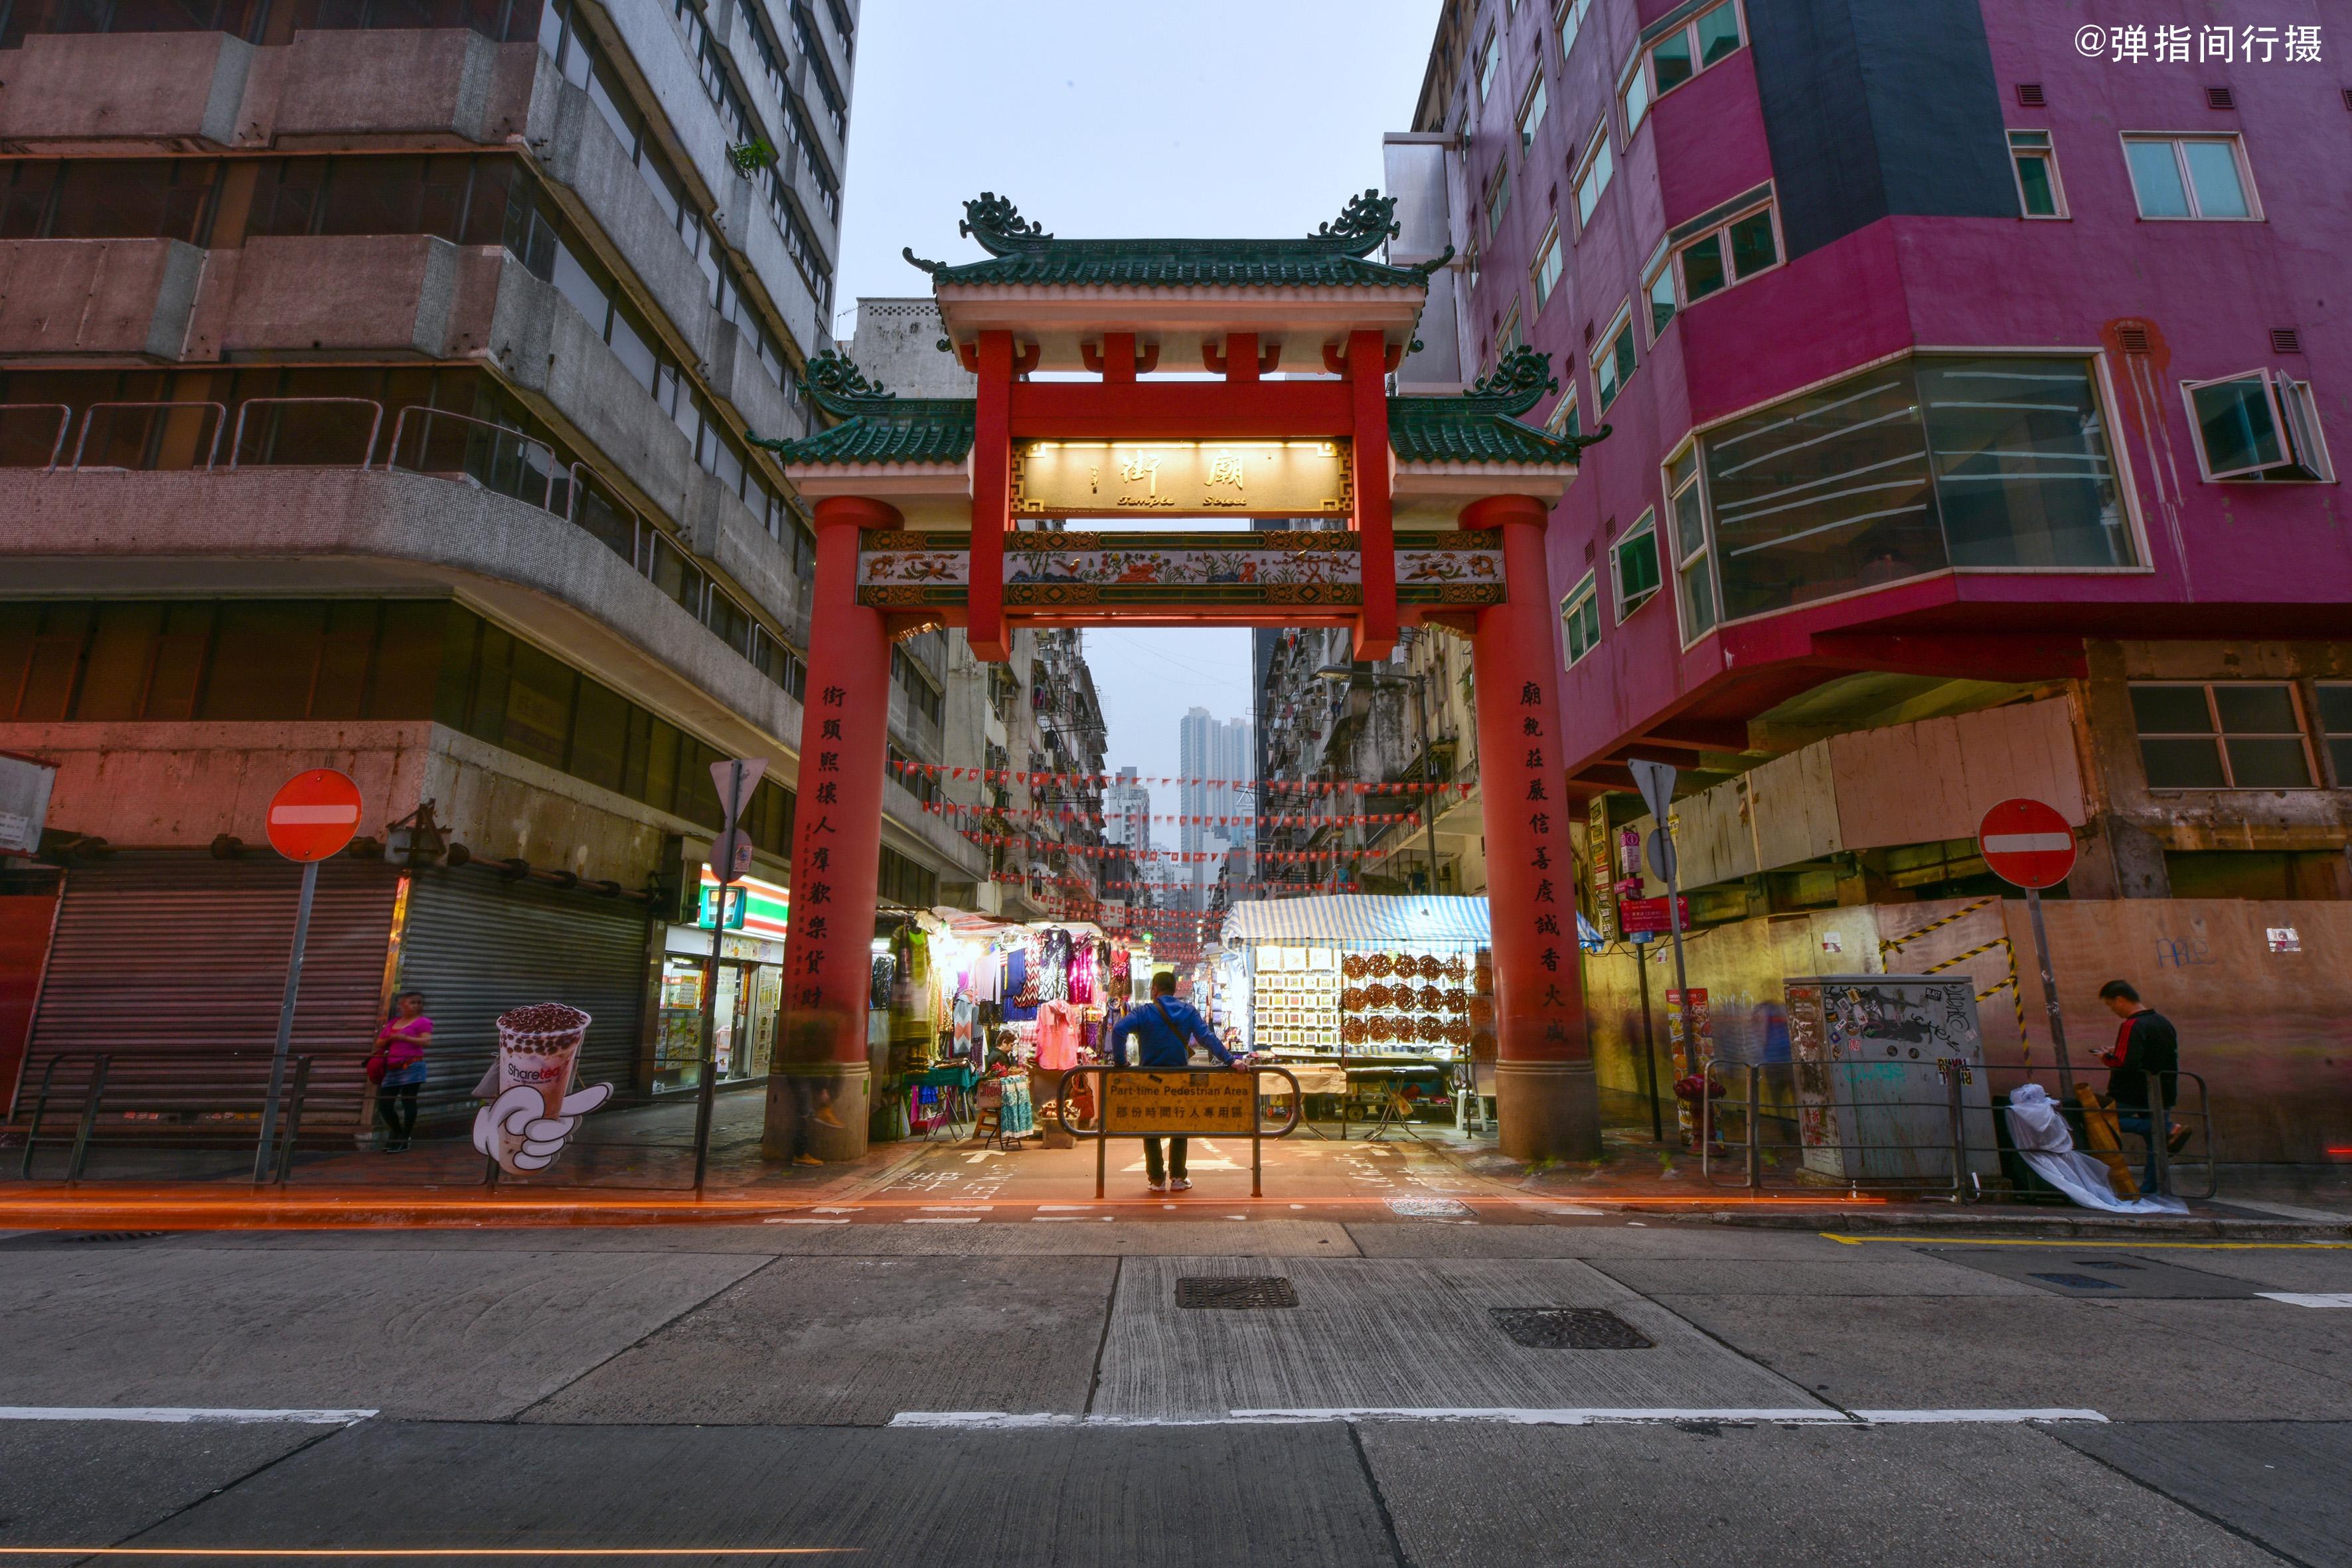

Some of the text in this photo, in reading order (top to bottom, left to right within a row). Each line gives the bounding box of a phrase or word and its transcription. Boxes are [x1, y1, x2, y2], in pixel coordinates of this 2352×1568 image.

[1117, 495, 1247, 508] Temple Street
[508, 1063, 560, 1080] Sharetea
[1111, 1085, 1248, 1095] Part-time Pedestrian Area
[1116, 1106, 1243, 1119] 部份時間行人專用區
